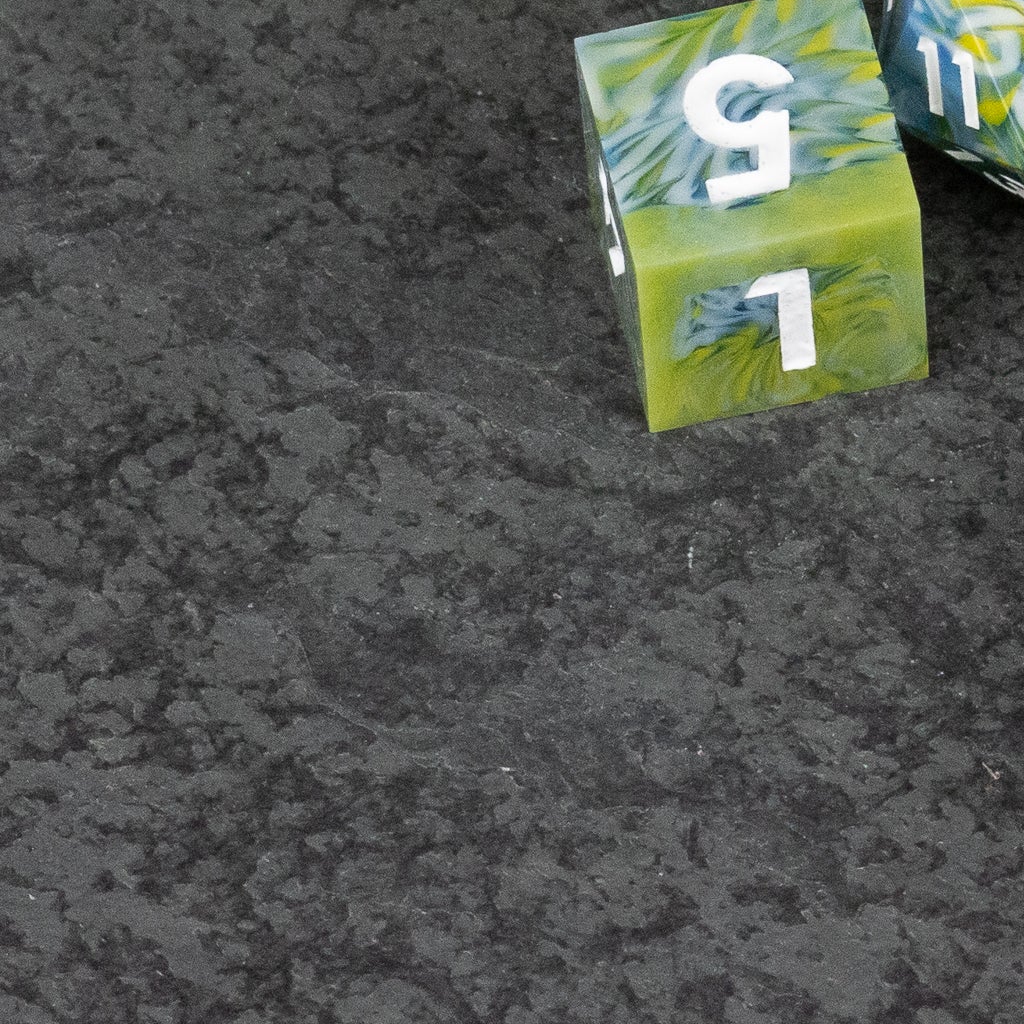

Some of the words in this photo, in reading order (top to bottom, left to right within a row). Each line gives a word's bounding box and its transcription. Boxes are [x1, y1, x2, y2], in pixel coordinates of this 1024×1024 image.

[684, 53, 795, 205] 5
[917, 37, 980, 130] 11
[744, 268, 816, 372] 1
